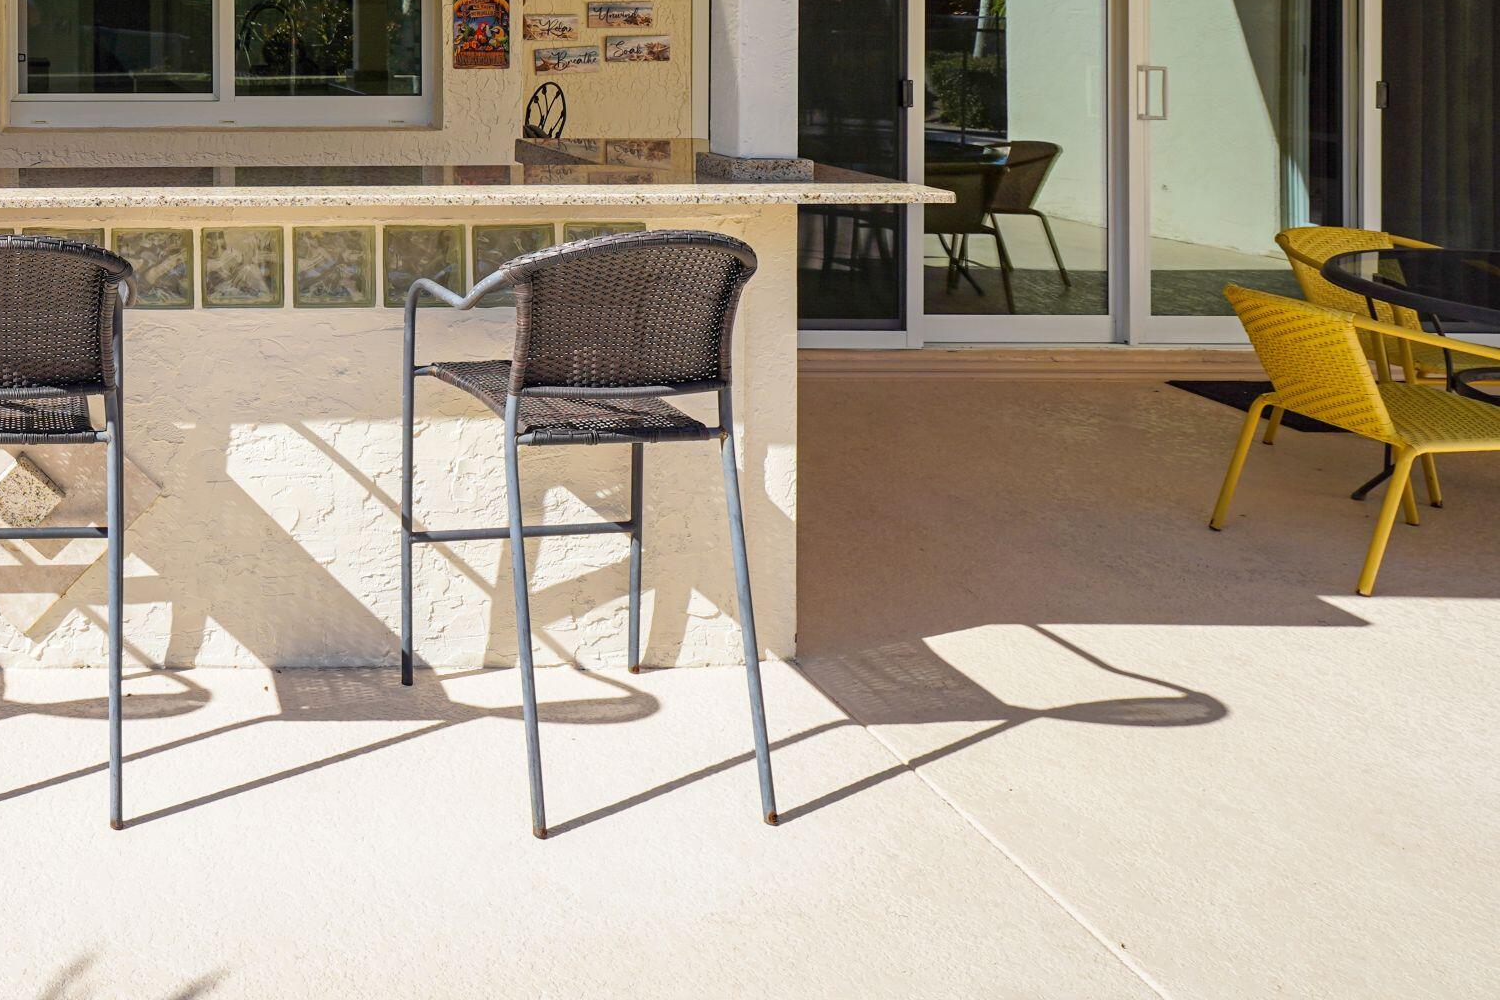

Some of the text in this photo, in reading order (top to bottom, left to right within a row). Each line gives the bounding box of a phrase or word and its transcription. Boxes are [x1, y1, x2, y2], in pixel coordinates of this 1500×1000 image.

[593, 6, 640, 24] Unwind
[539, 17, 574, 37] Relax
[612, 40, 643, 59] Soak
[551, 50, 599, 71] Breathe
